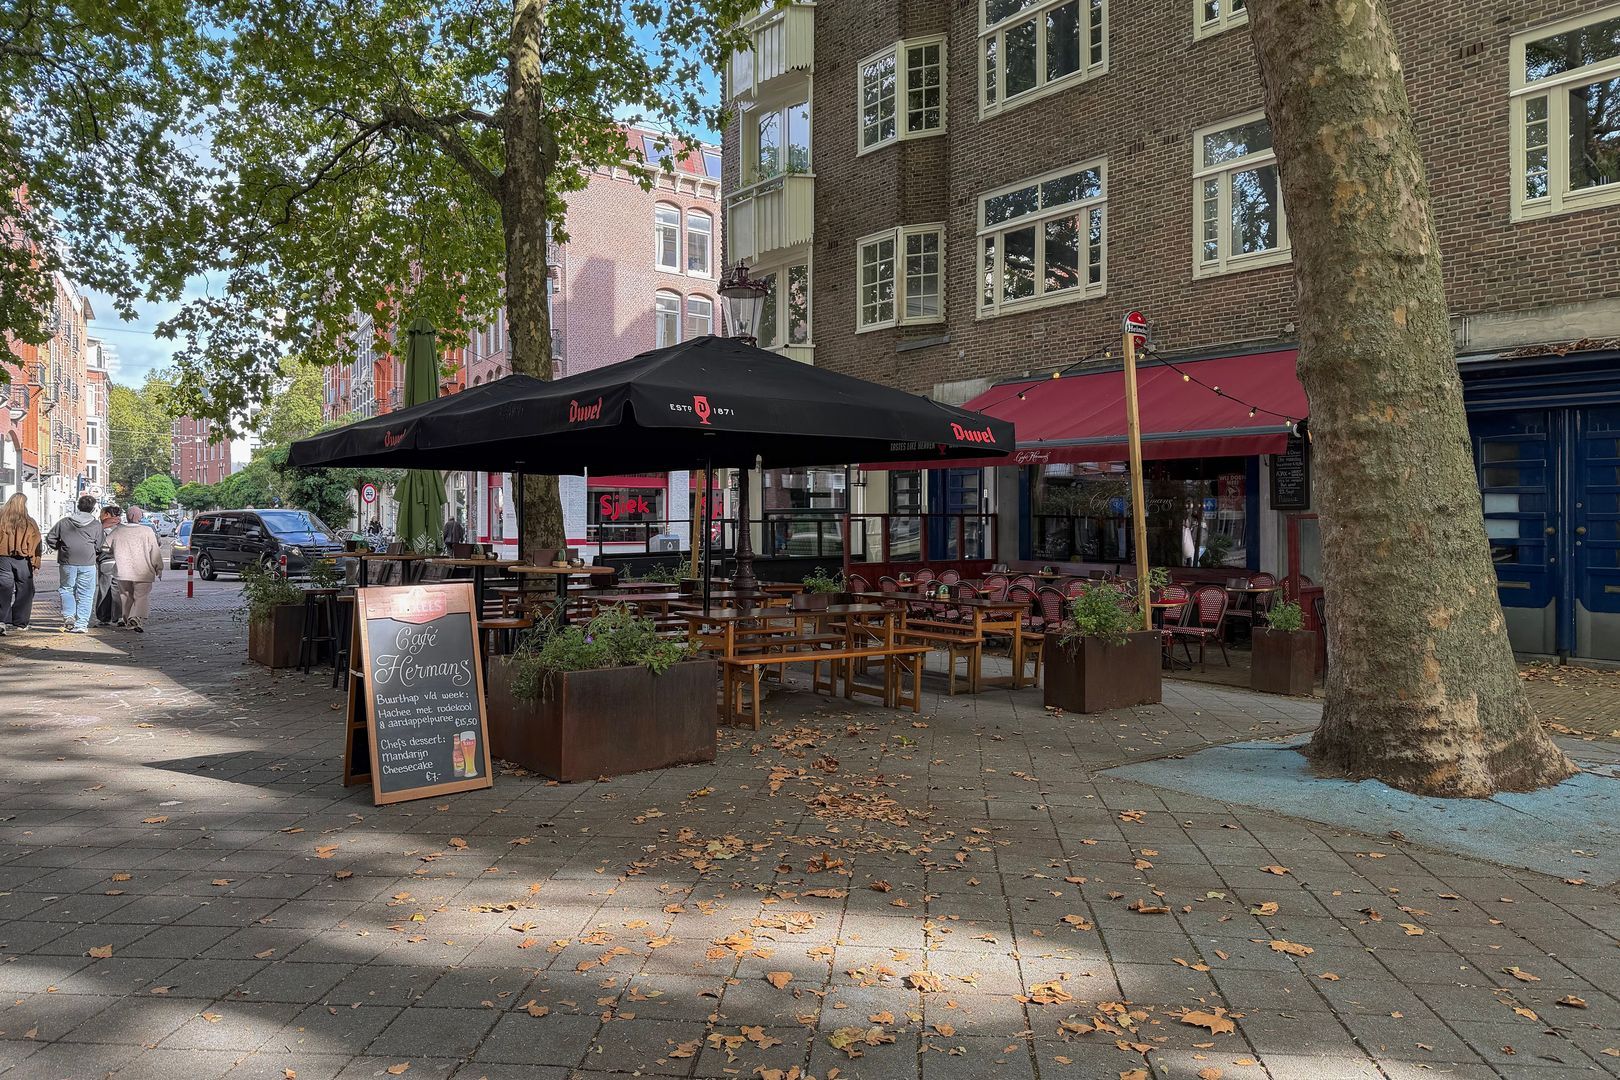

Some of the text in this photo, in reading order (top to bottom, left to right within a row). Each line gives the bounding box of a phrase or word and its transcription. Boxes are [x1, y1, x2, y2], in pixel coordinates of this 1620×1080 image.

[569, 396, 603, 424] Duvel
[713, 407, 735, 416] 1871
[950, 422, 996, 444] Duvel
[599, 494, 651, 521] Sjiek
[395, 625, 439, 654] Café
[374, 654, 472, 687] Hermans
[376, 693, 420, 705] Buurthap
[424, 691, 438, 700] v/d
[378, 702, 472, 719] Hachee met rodekool
[379, 720, 385, 729] &
[388, 715, 454, 728] aardappelpuree
[380, 734, 446, 750] Chefs dessert:
[382, 749, 429, 763] Mandarijn
[382, 761, 434, 775] Cheesecake
